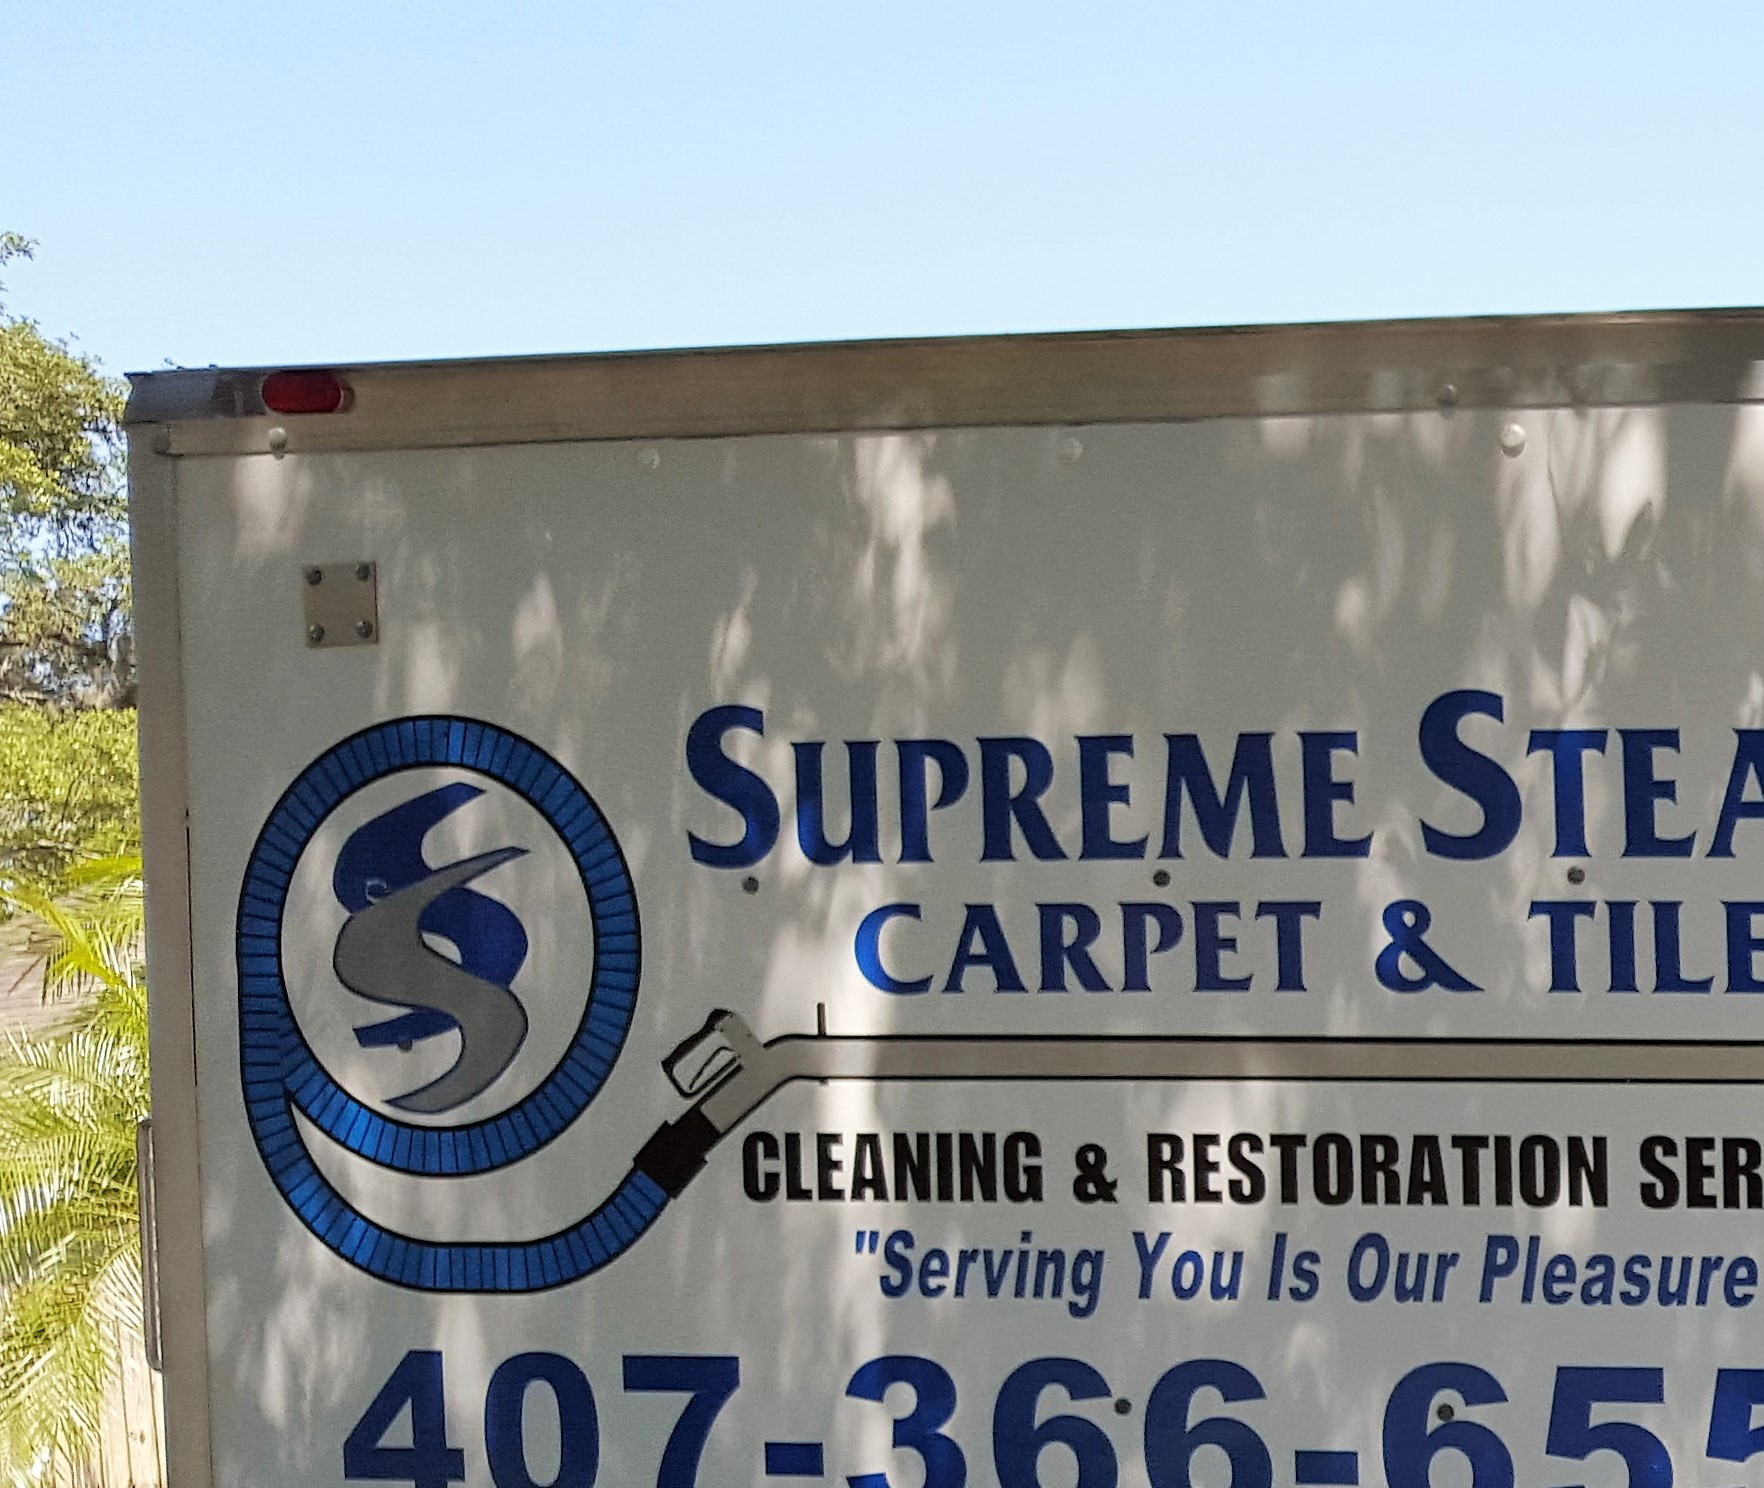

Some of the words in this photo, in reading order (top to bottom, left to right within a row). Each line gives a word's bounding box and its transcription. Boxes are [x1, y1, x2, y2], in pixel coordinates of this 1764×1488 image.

[686, 704, 1373, 869] SUPREME
[855, 901, 1323, 995] CARPET
[1375, 900, 1484, 993] &
[742, 1131, 1043, 1203] CLEANING
[1073, 1144, 1117, 1203] &
[1147, 1133, 1608, 1207] RESTORATION
[856, 1230, 1104, 1318] "Serving
[1132, 1231, 1243, 1300] You
[1268, 1232, 1320, 1301] Is
[1348, 1233, 1460, 1303] Our
